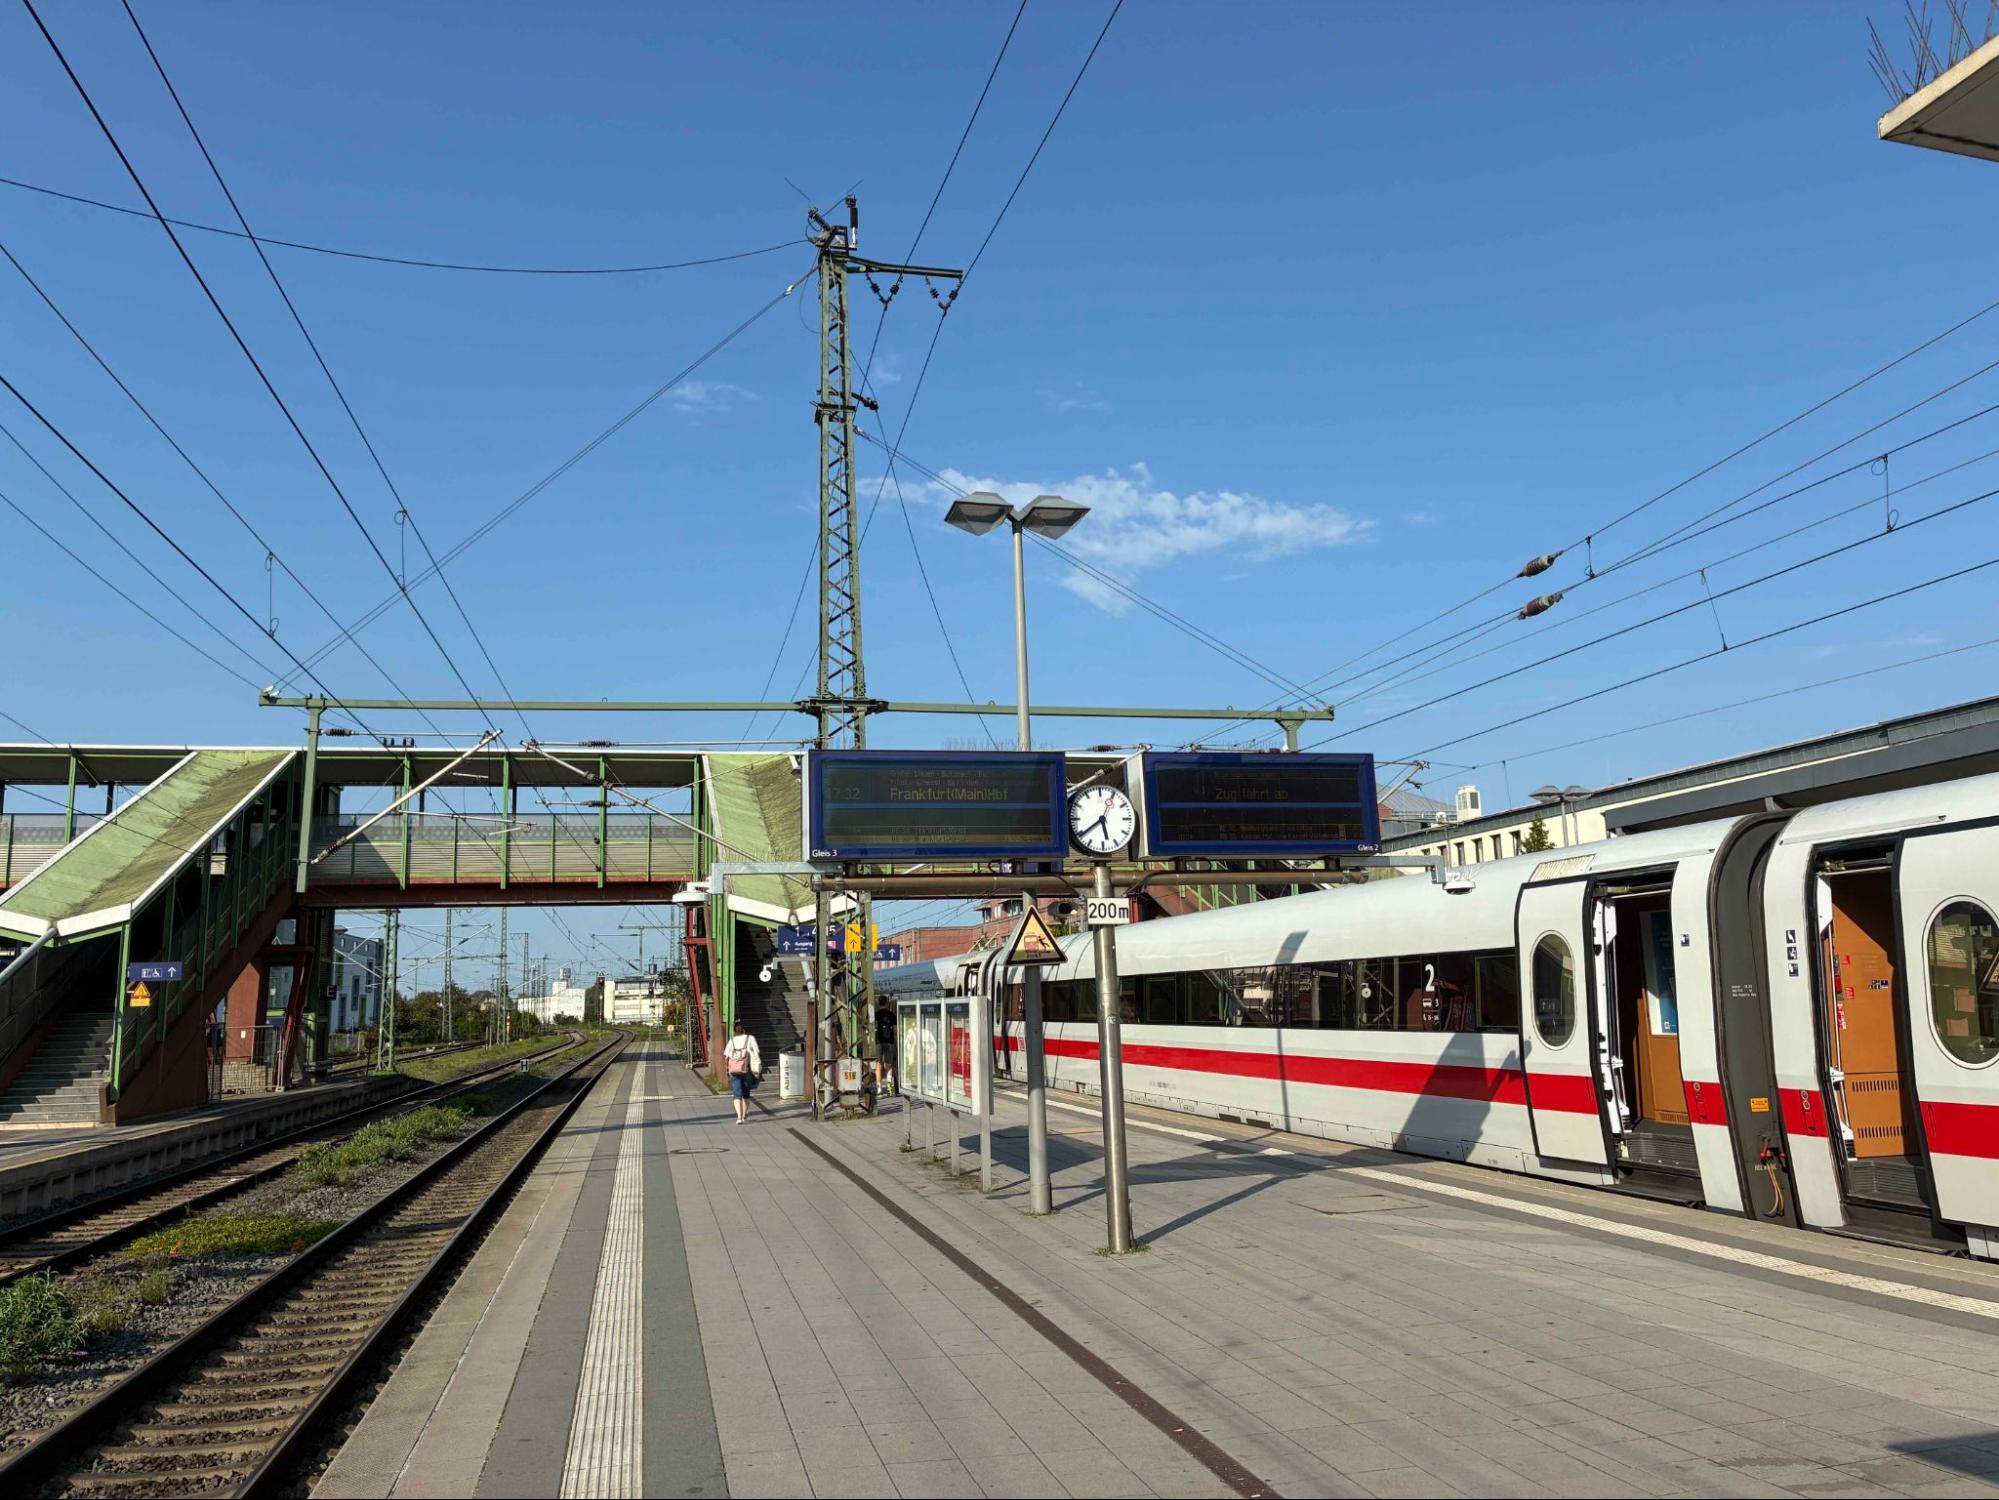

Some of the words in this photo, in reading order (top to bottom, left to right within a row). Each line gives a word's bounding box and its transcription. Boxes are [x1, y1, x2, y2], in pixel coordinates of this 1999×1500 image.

[811, 849, 831, 857] Gleis
[832, 849, 838, 857] 3
[1357, 843, 1374, 851] Gleis
[1424, 963, 1435, 992] 2
[326, 985, 335, 997] E
[520, 1060, 528, 1072] H
